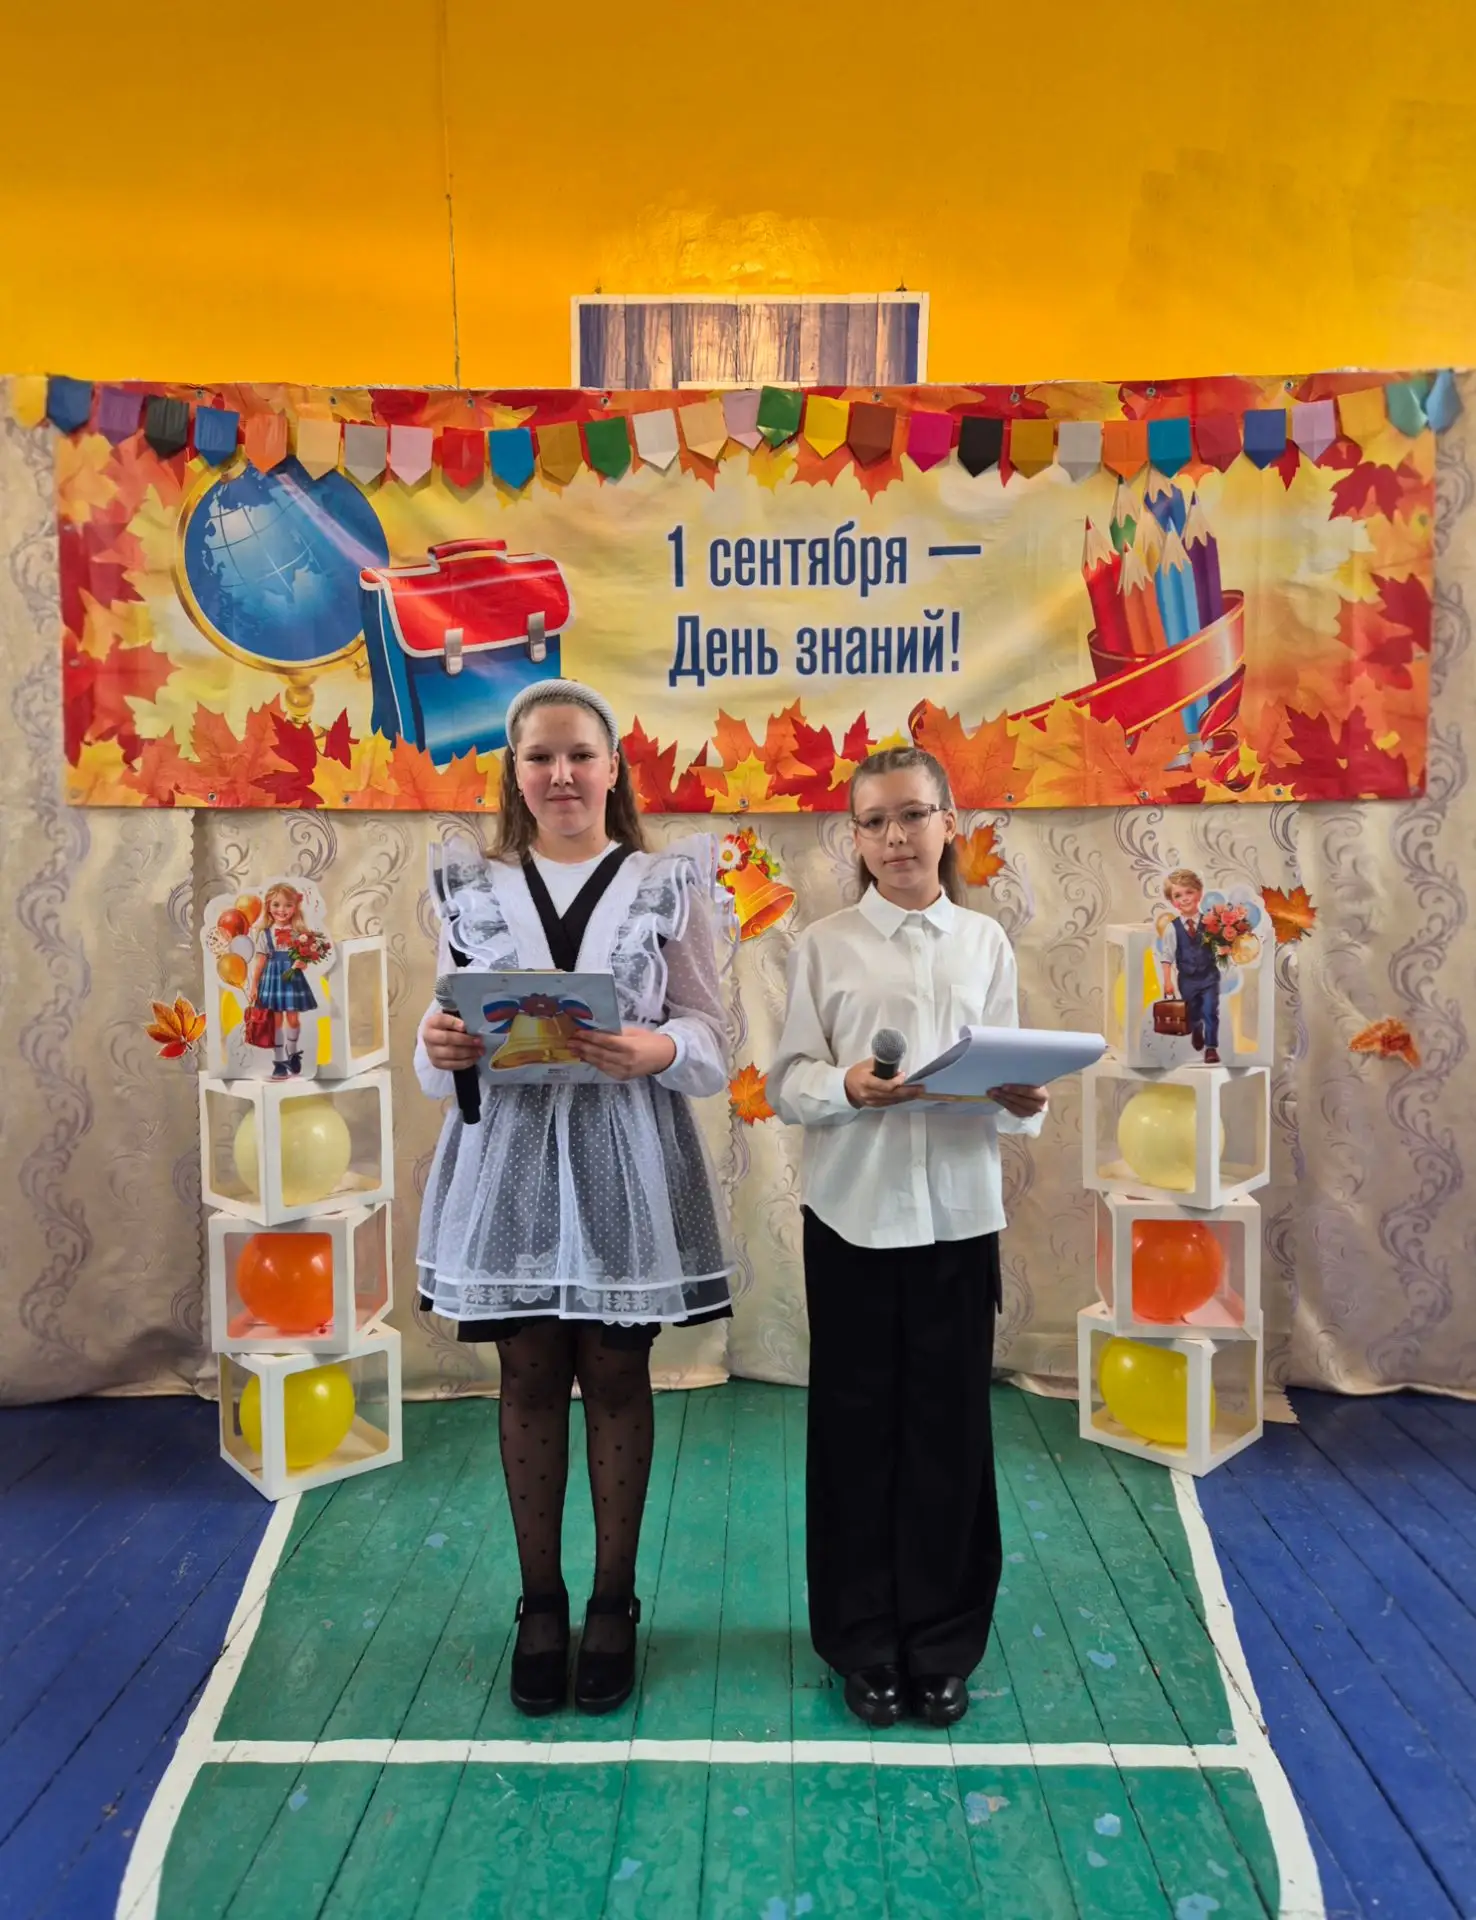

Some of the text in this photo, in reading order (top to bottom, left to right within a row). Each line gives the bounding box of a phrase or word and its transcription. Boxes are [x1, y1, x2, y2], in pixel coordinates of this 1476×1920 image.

[667, 525, 684, 587] 1
[709, 520, 907, 598] сентября
[668, 608, 960, 687] День знаний!
